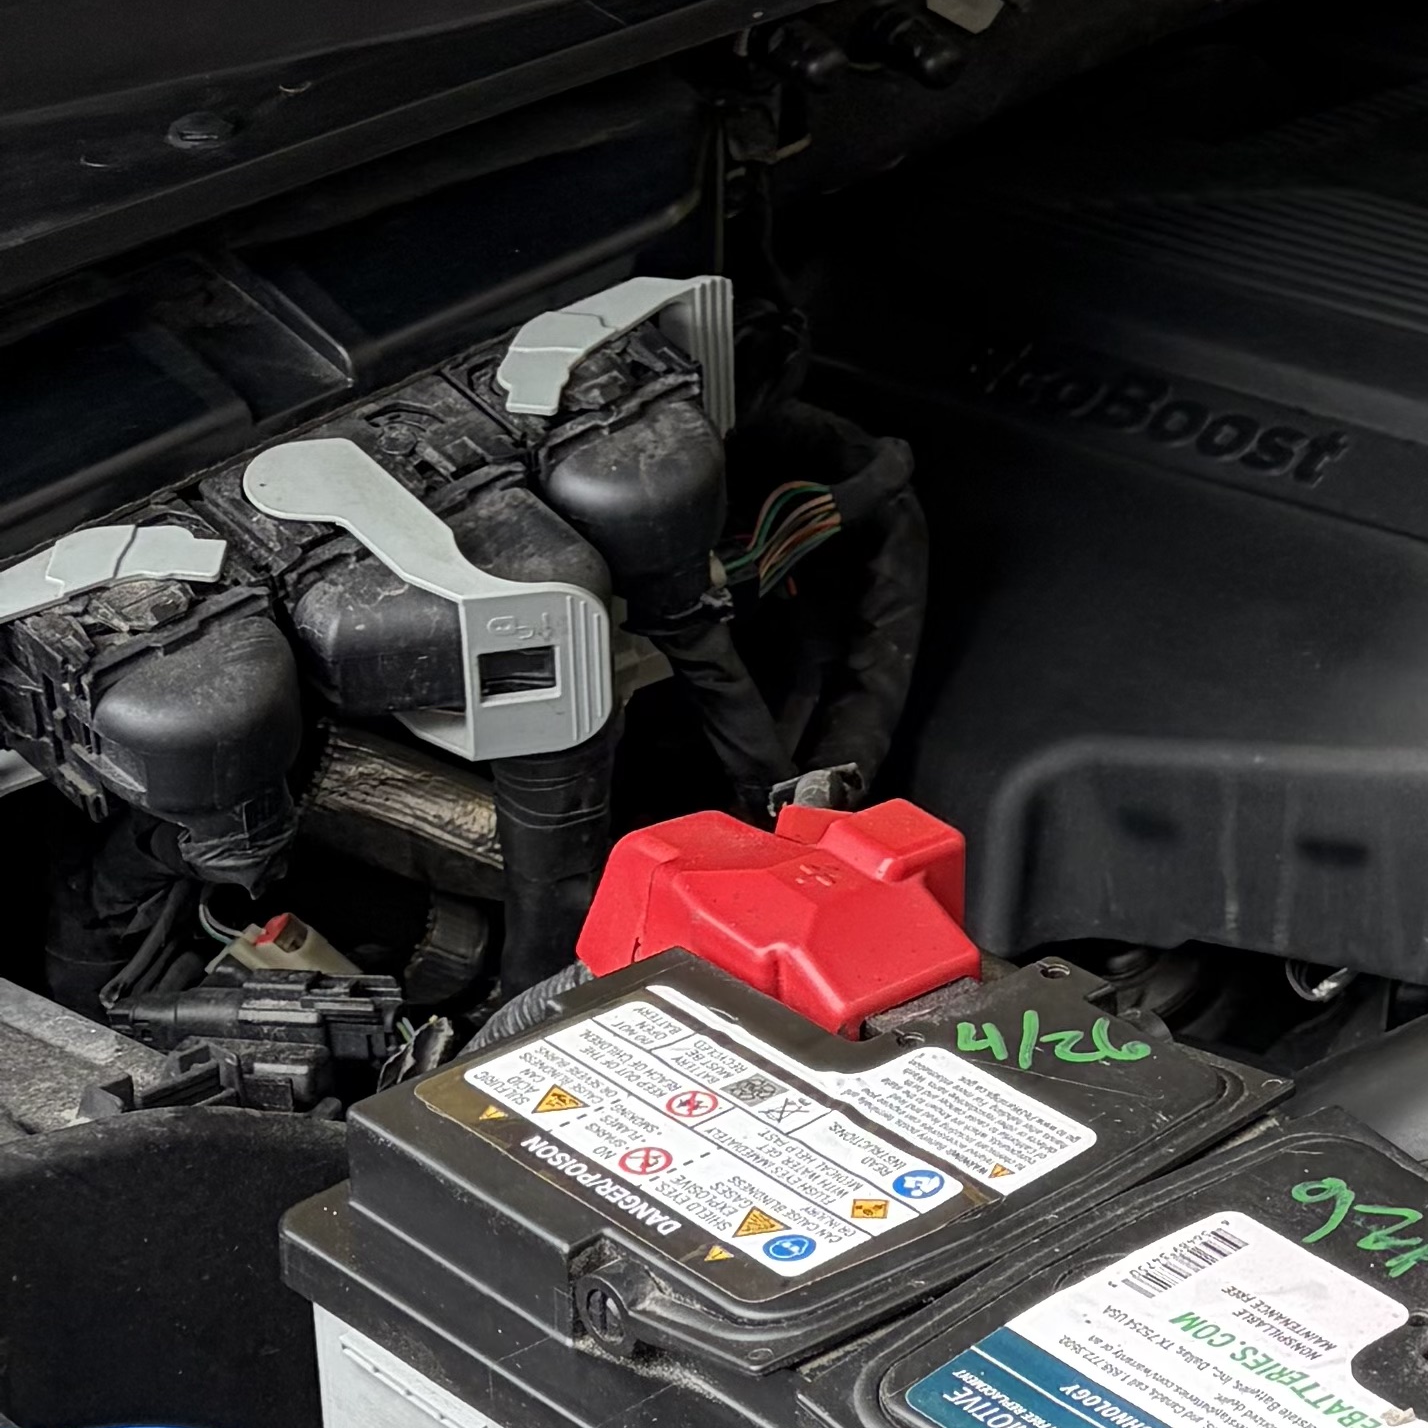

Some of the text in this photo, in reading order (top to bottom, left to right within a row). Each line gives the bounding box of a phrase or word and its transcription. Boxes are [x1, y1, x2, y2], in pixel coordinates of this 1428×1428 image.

[978, 338, 1352, 490] coBoost
[610, 1021, 655, 1045] DO NOT
[632, 1006, 682, 1035] BATTERY
[634, 1020, 668, 1041] OPEN
[957, 1010, 1152, 1070] 4/26
[627, 1060, 649, 1072] OF
[670, 1055, 720, 1085] BATTERY
[684, 1048, 735, 1079] MUST BE
[693, 1039, 748, 1074] RECYCLED
[506, 1075, 540, 1094] ACID
[518, 1067, 546, 1083] CAN
[518, 1051, 604, 1104] CAUSE BLINDNESS
[565, 1065, 604, 1089] SEVERE
[578, 1045, 668, 1098] KEEP OUT OF THE
[642, 1068, 682, 1092] REACH
[473, 1070, 530, 1106] SULFURIC
[599, 1085, 618, 1098] OR
[599, 1114, 643, 1141] FLAMES
[609, 1103, 659, 1133] SMOKING
[584, 1122, 627, 1148] SPARKS
[592, 1145, 617, 1160] NO
[755, 1143, 783, 1159] GET
[784, 1145, 817, 1164] HELP
[704, 1127, 837, 1206] FLUSH EYES IMMEDIATELY
[814, 1161, 864, 1191] MEDICAL
[860, 1155, 893, 1177] READ
[521, 1136, 680, 1234] DANGER/POISON
[669, 1174, 738, 1217] EXPLOSIVE
[709, 1181, 754, 1209] GASES
[816, 1178, 849, 1199] WITH
[685, 1201, 733, 1232] SHIELD
[727, 1175, 843, 1244] CAN CAUSE BLINDNESS
[1102, 1304, 1129, 1323] USA
[1250, 1299, 1337, 1351] MAINTENANCE
[1154, 1337, 1175, 1351] TX
[1232, 1308, 1322, 1360] NONSPILLABLE
[952, 1369, 1027, 1415] REPLACEMENT
